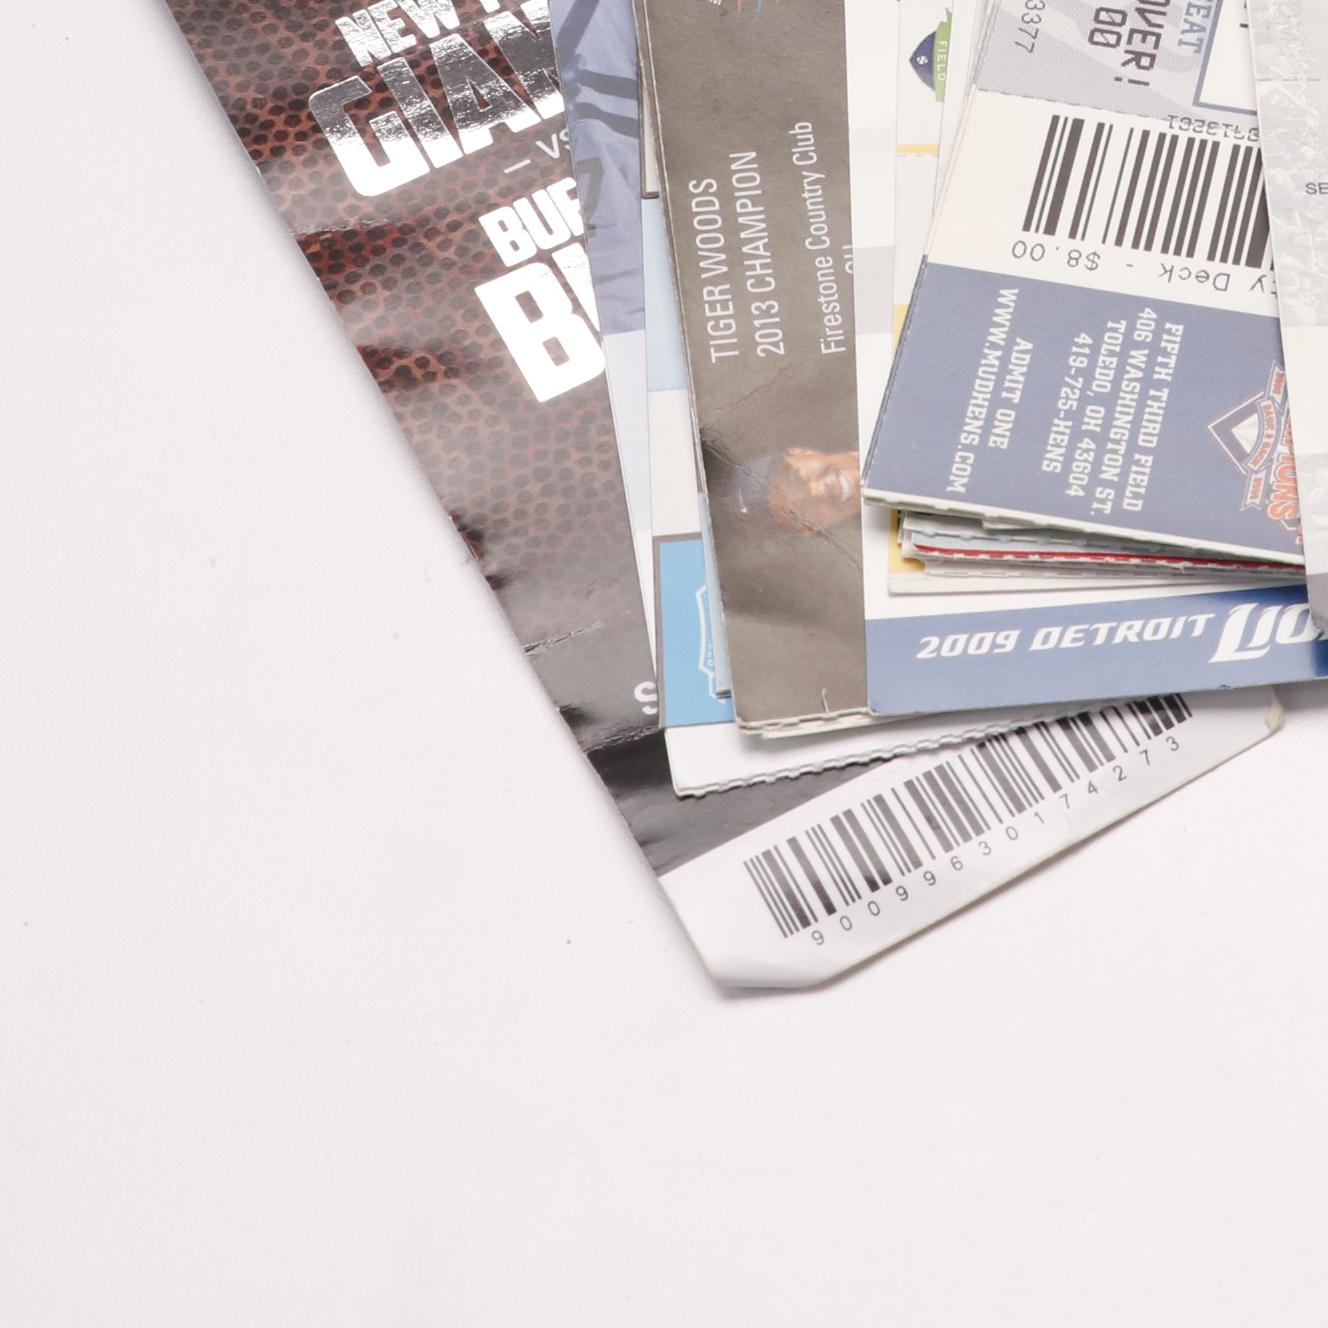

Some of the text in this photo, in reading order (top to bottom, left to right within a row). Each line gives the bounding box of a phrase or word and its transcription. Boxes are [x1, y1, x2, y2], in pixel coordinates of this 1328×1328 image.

[689, 178, 739, 363] TIGER WOODS
[729, 151, 786, 358] 2013 CHAMPION
[789, 121, 846, 354] Firestone Country Club
[1010, 240, 1231, 293] Deck $8.00
[946, 287, 1019, 494] WWW.MUDHENS.COM
[988, 336, 1035, 450] ADMIT ONE
[1042, 331, 1094, 474] 419-725-HENS
[1066, 318, 1127, 498] TOLEDO, OH 43604
[1089, 306, 1157, 518] 406 WASHINGTON ST.
[1123, 322, 1184, 512] FIFTH THIRD FIELD
[916, 613, 1215, 660] 2009 DETROIT
